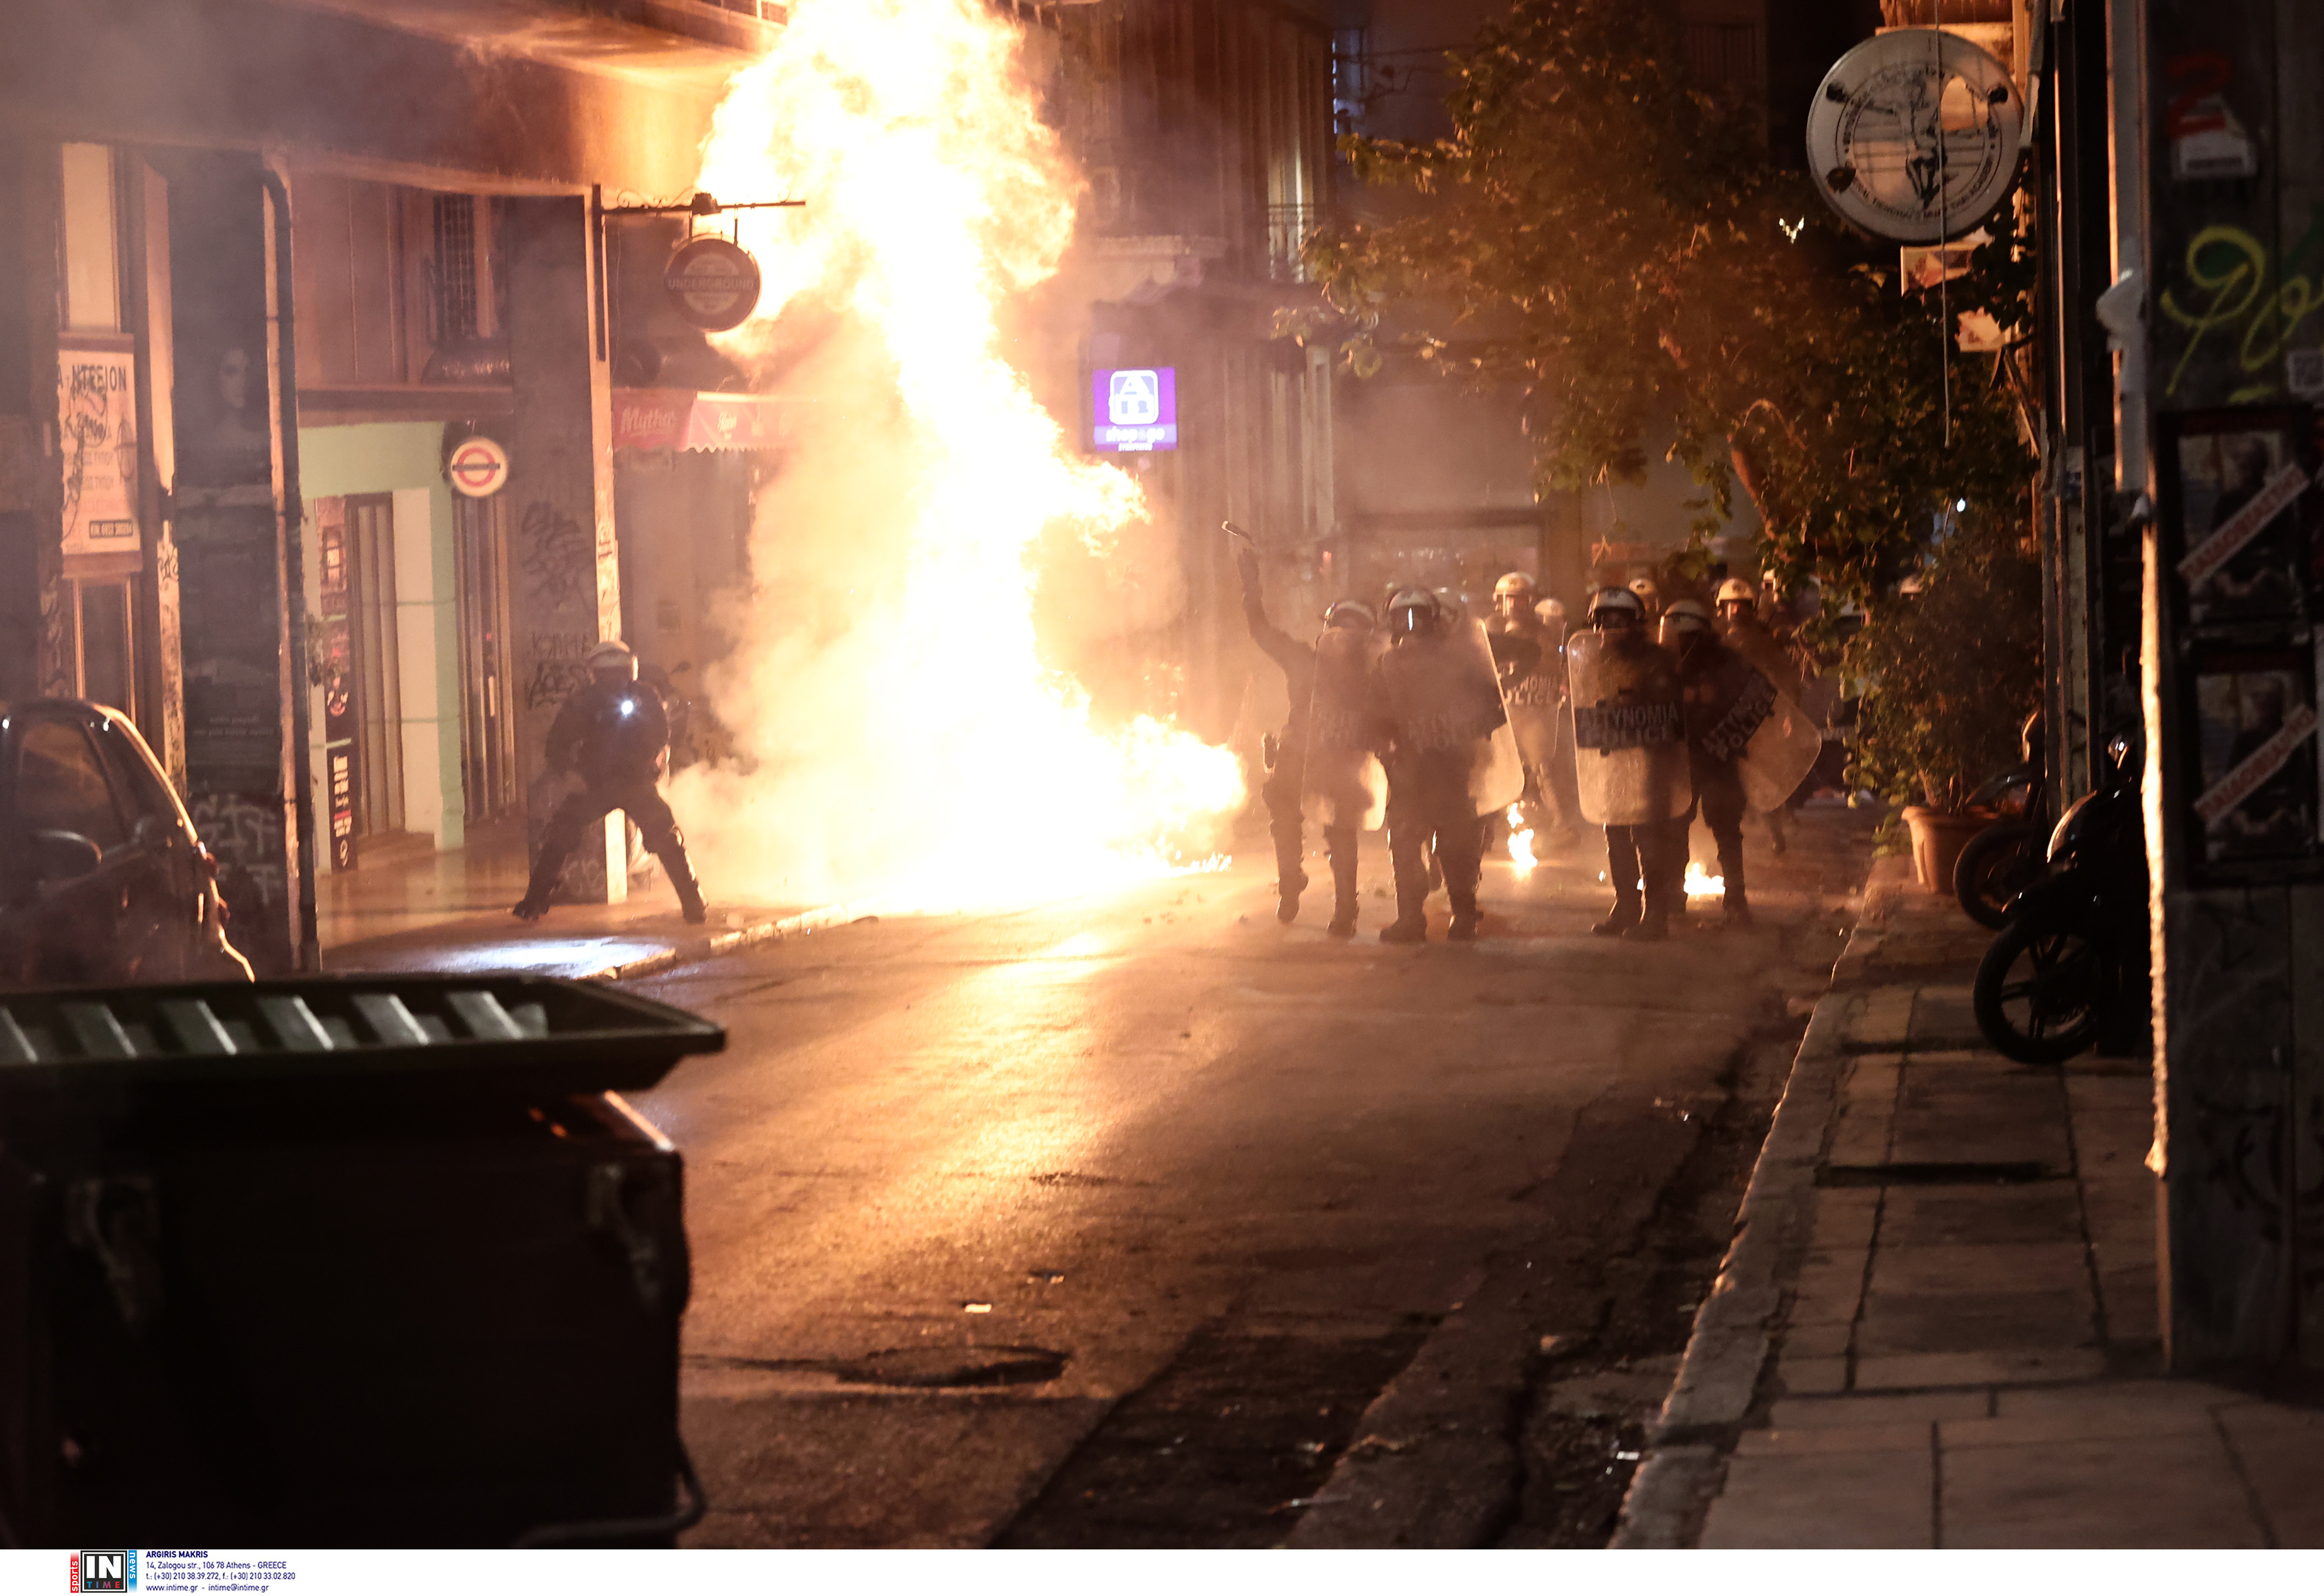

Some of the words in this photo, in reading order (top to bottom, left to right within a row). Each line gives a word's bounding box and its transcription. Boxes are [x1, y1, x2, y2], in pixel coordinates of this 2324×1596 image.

[1105, 426, 1138, 443] shop
[1147, 428, 1165, 443] go
[1585, 725, 1675, 746] POLICE
